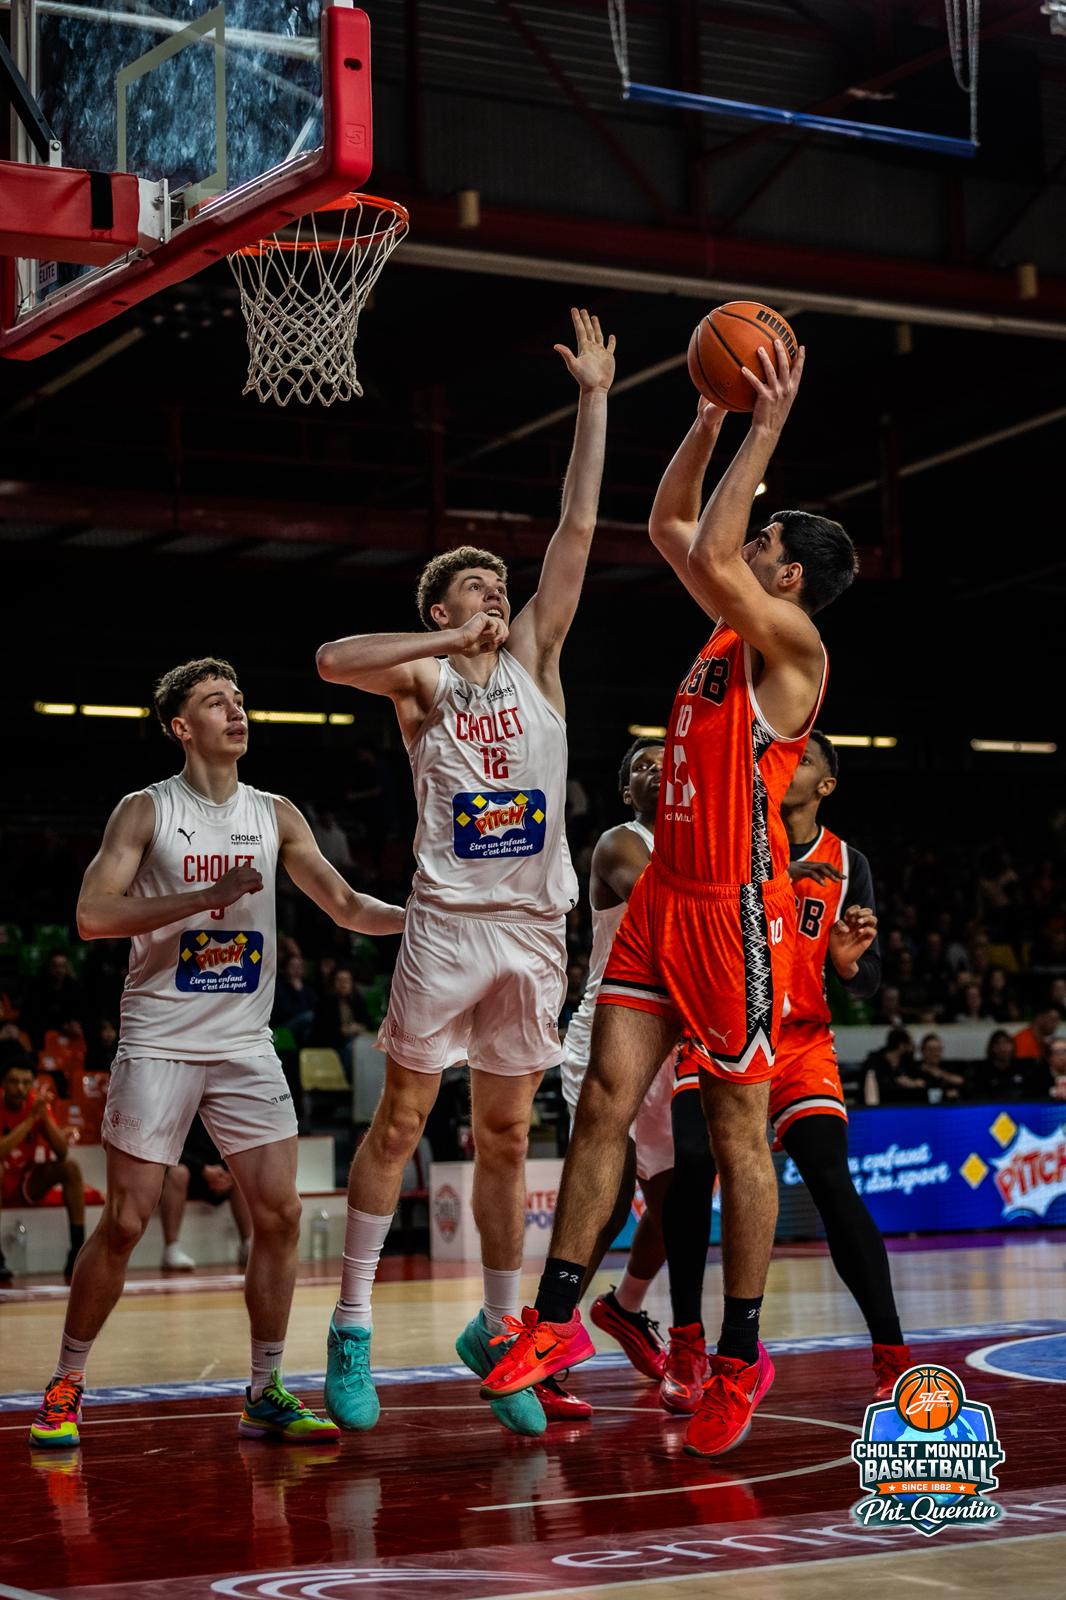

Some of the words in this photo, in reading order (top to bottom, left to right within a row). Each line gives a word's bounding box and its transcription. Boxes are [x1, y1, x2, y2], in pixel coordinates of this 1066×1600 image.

[456, 707, 523, 744] CHOLET
[675, 704, 693, 737] 10
[480, 747, 509, 779] 12
[469, 842, 487, 851] Etre
[500, 837, 527, 847] enfant
[482, 848, 500, 856] c'est
[512, 843, 533, 853] sport
[770, 916, 783, 946] 10
[189, 976, 206, 985] Etre
[218, 974, 243, 985] enfant
[202, 983, 218, 991] c'est
[229, 981, 247, 991] sport
